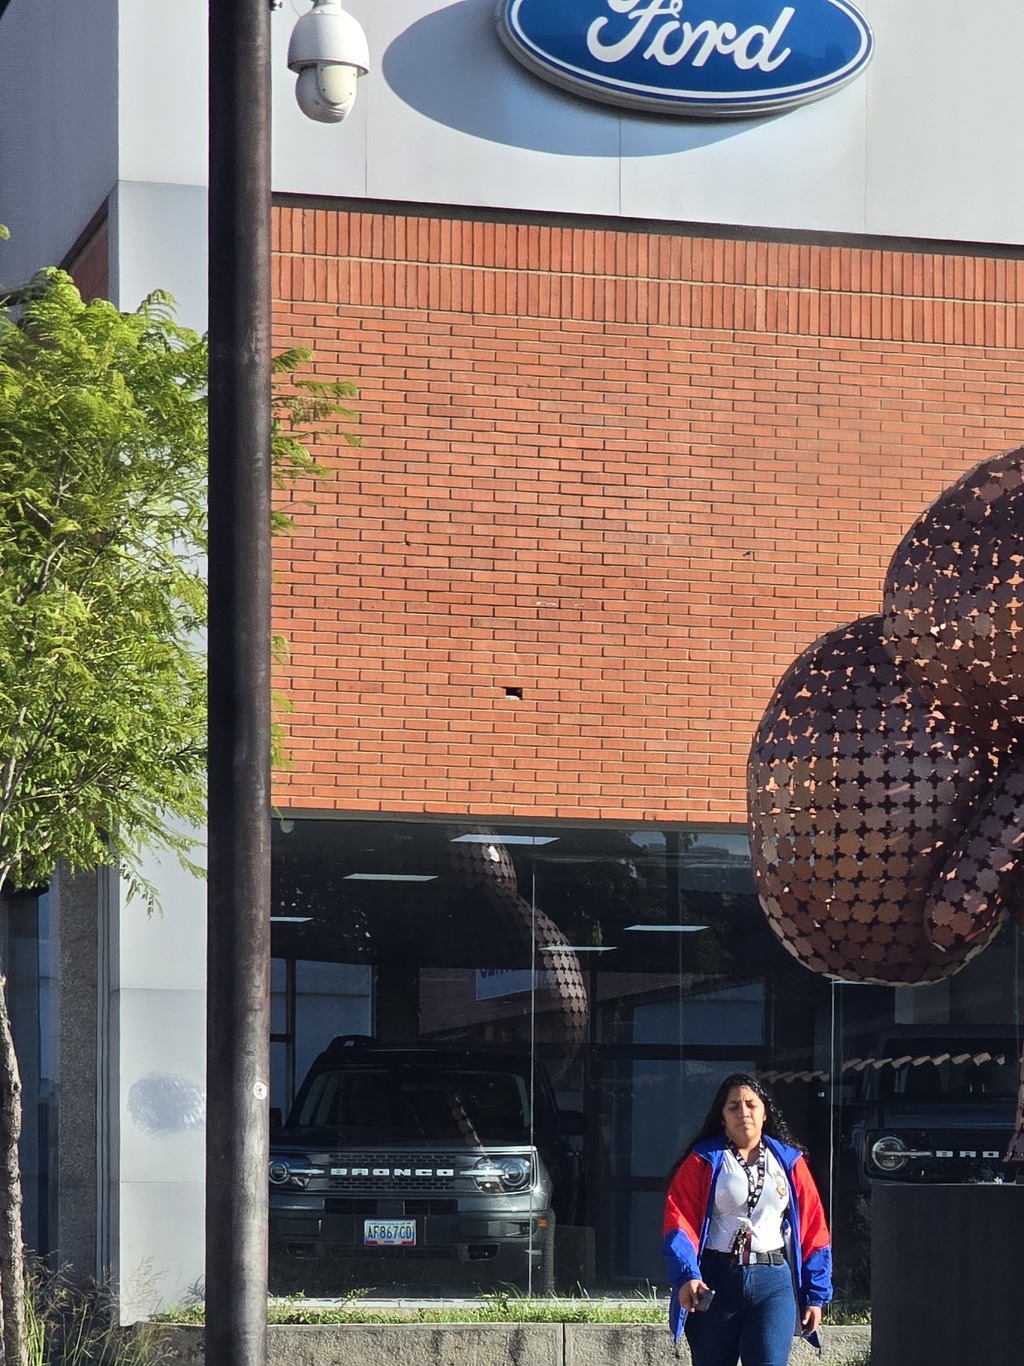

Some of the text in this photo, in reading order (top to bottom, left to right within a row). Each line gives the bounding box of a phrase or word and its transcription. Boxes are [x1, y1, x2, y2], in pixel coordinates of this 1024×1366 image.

[586, 0, 796, 72] Ford
[330, 1168, 454, 1176] BRONCO
[368, 1225, 412, 1239] AF867CD
